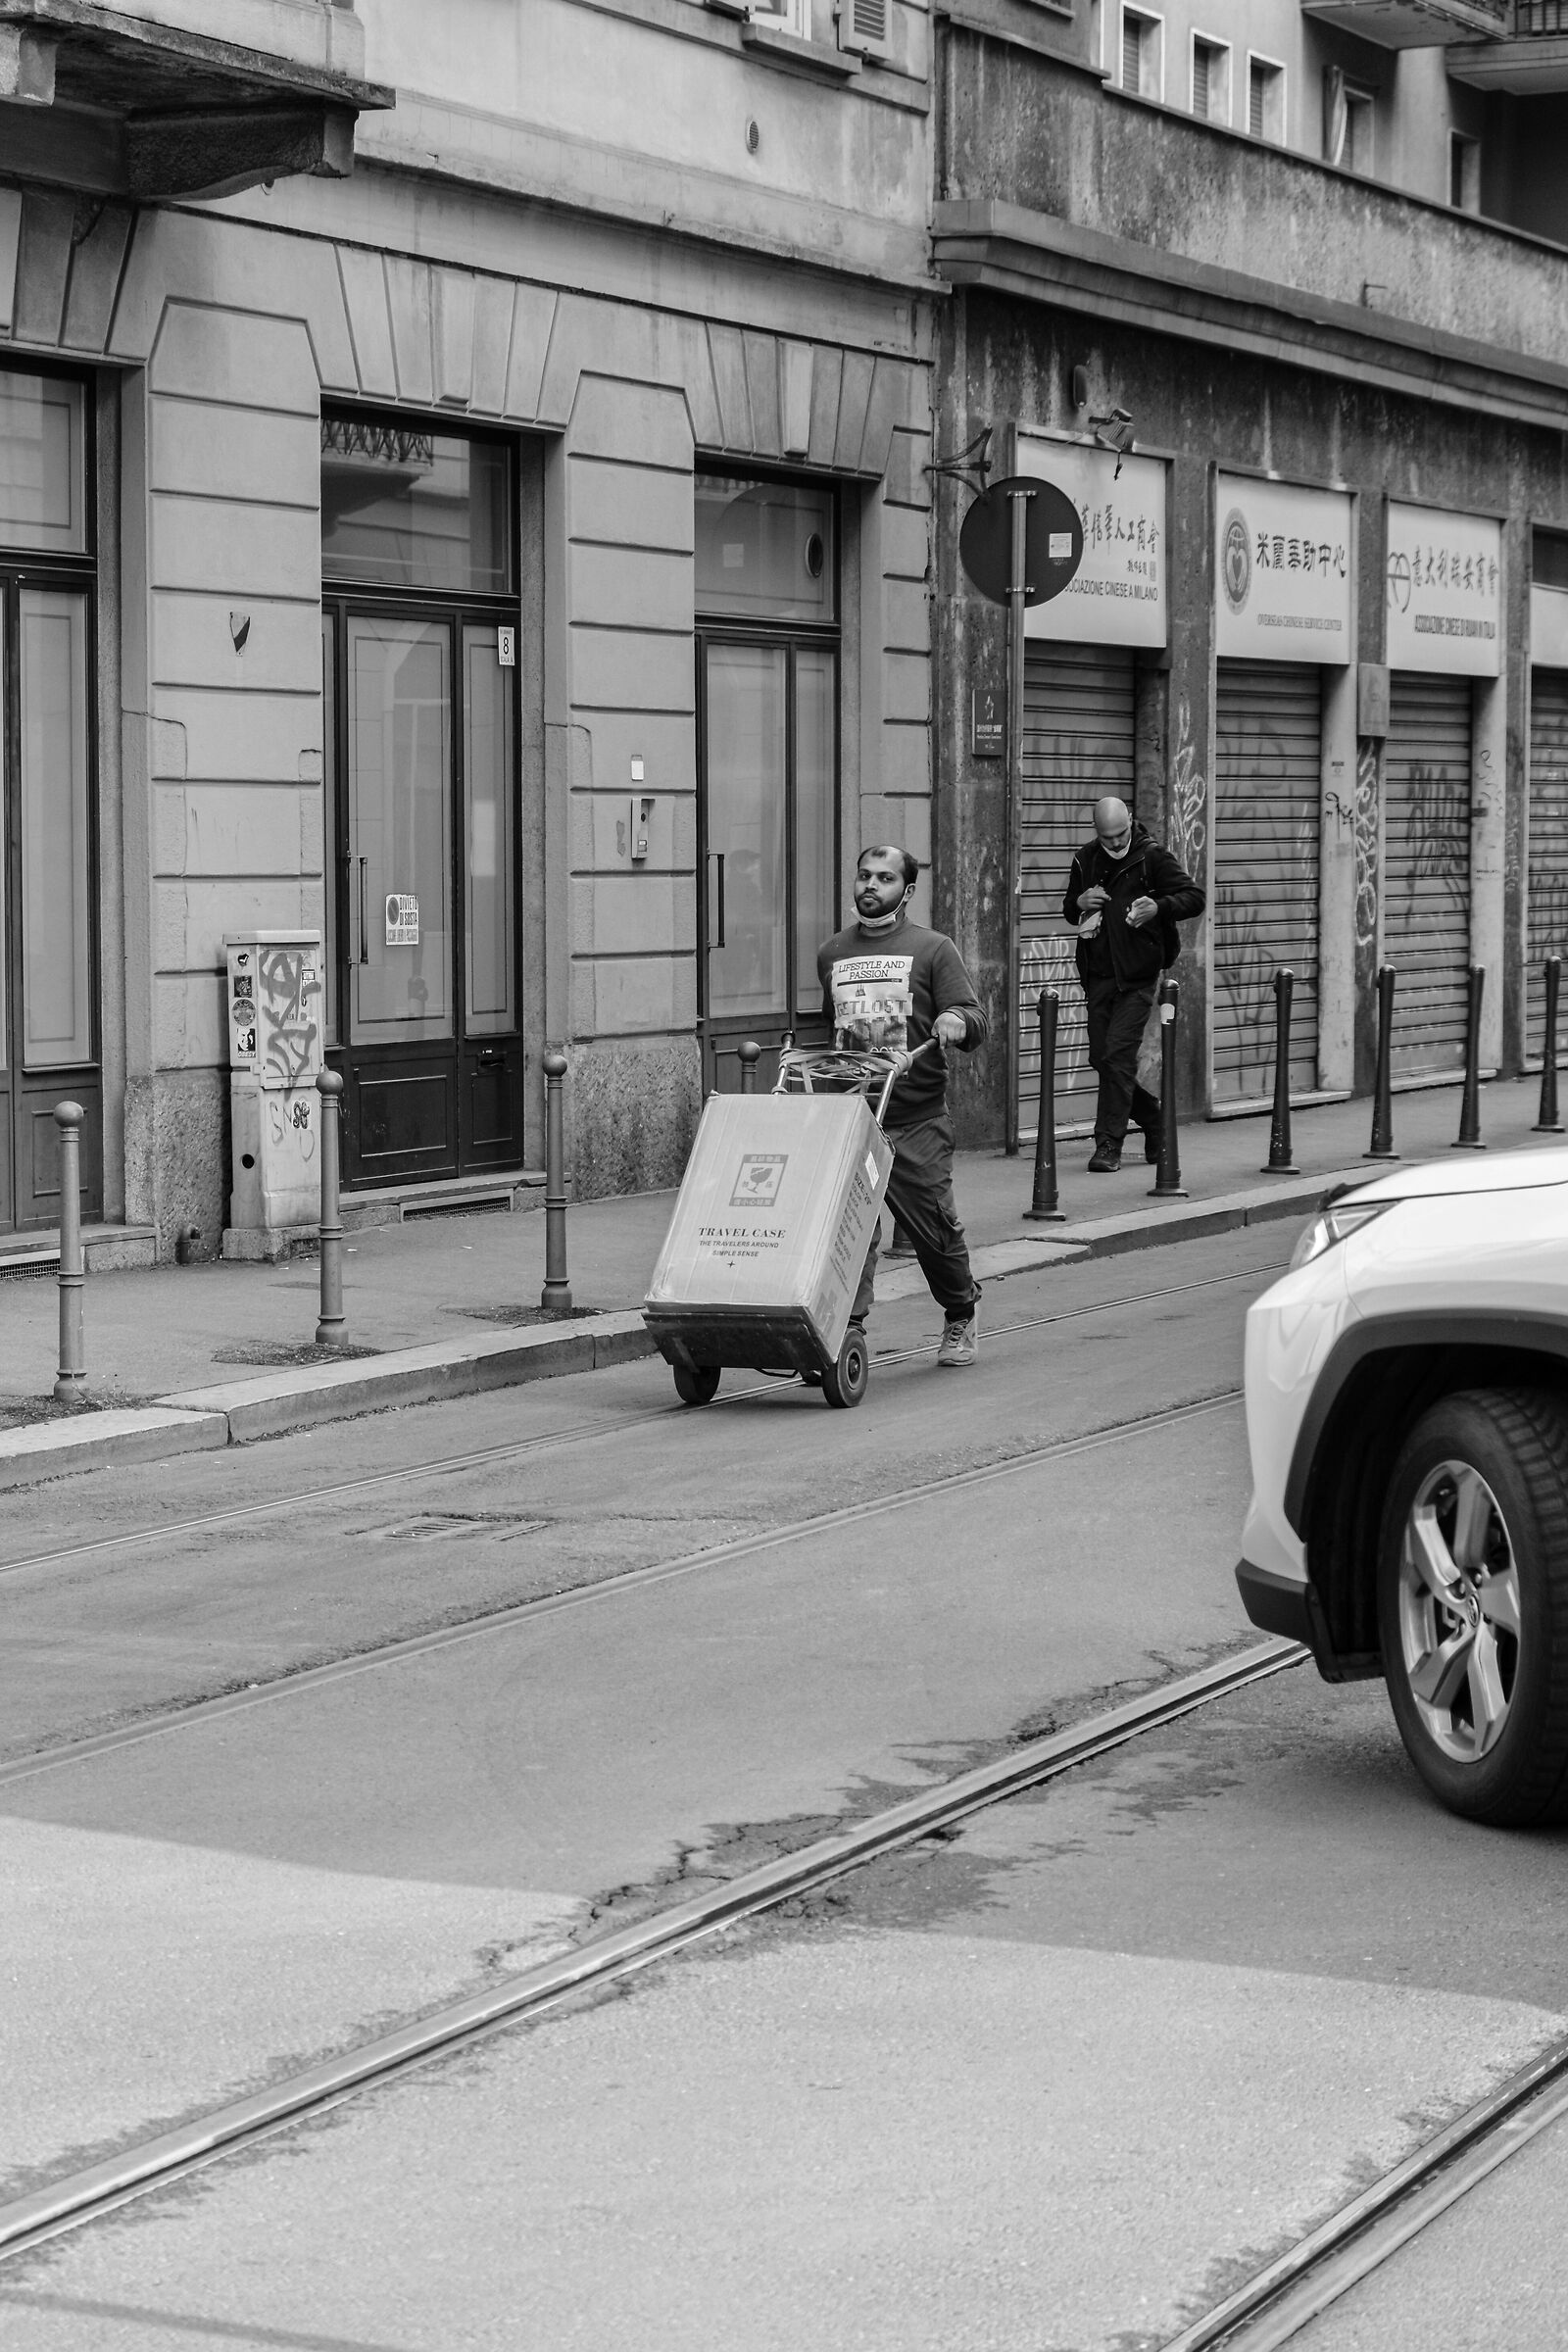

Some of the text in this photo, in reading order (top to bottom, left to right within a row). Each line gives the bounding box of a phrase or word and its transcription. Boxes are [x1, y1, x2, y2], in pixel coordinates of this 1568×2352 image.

[1104, 581, 1128, 598] CINESE
[1134, 585, 1158, 601] MILANO
[503, 636, 510, 655] 8
[399, 896, 417, 910] DIVIETO
[399, 911, 404, 925] DI
[839, 960, 906, 973] LIFESTYLE AND
[849, 970, 889, 980] PASSION
[699, 1227, 786, 1239] TRAVEL CASE
